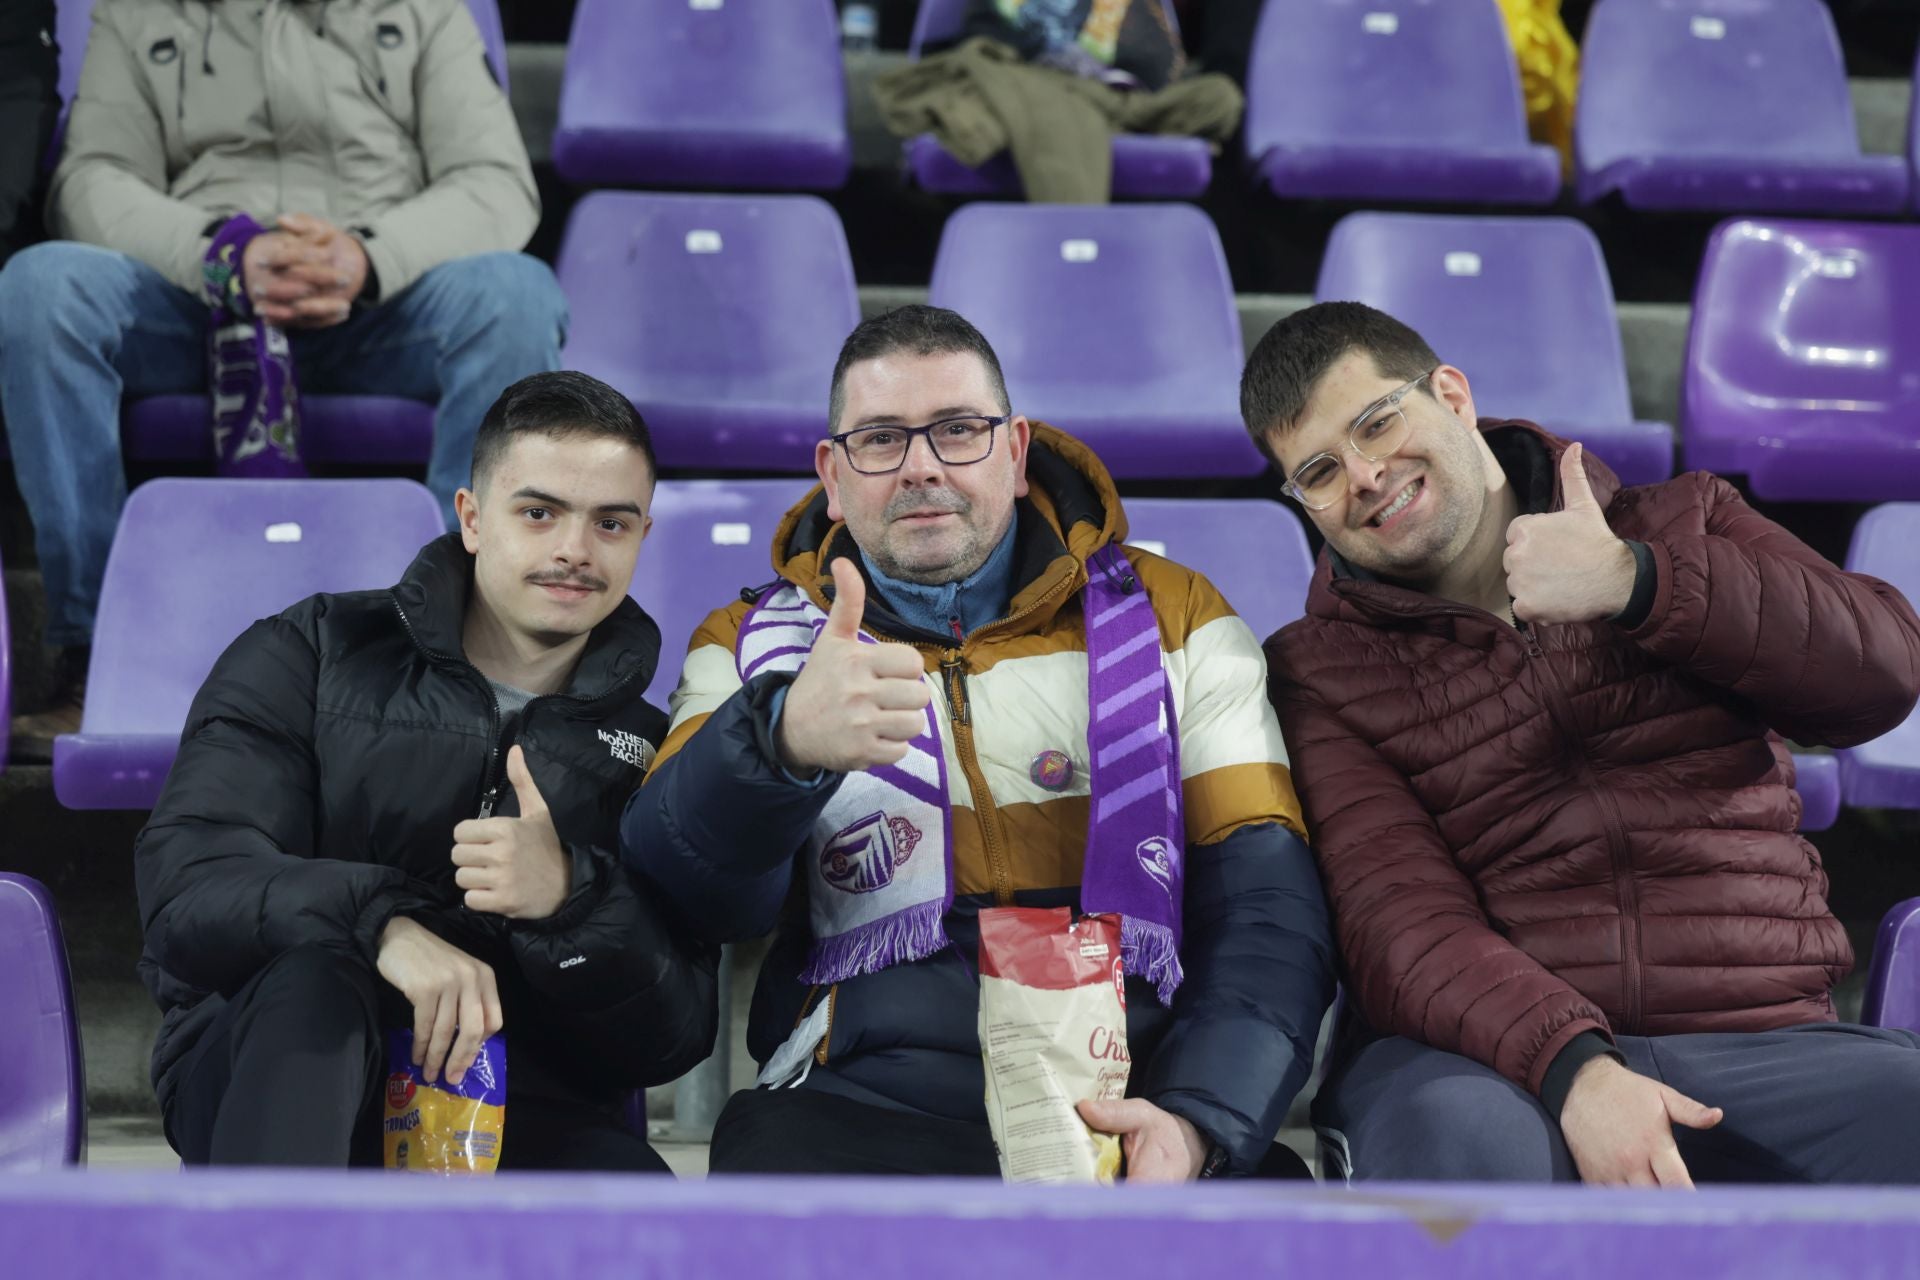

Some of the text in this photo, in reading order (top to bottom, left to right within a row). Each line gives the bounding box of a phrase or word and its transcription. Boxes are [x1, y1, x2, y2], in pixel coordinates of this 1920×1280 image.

[597, 729, 642, 757] NORTH
[615, 729, 642, 744] THE
[611, 745, 643, 769] FACE
